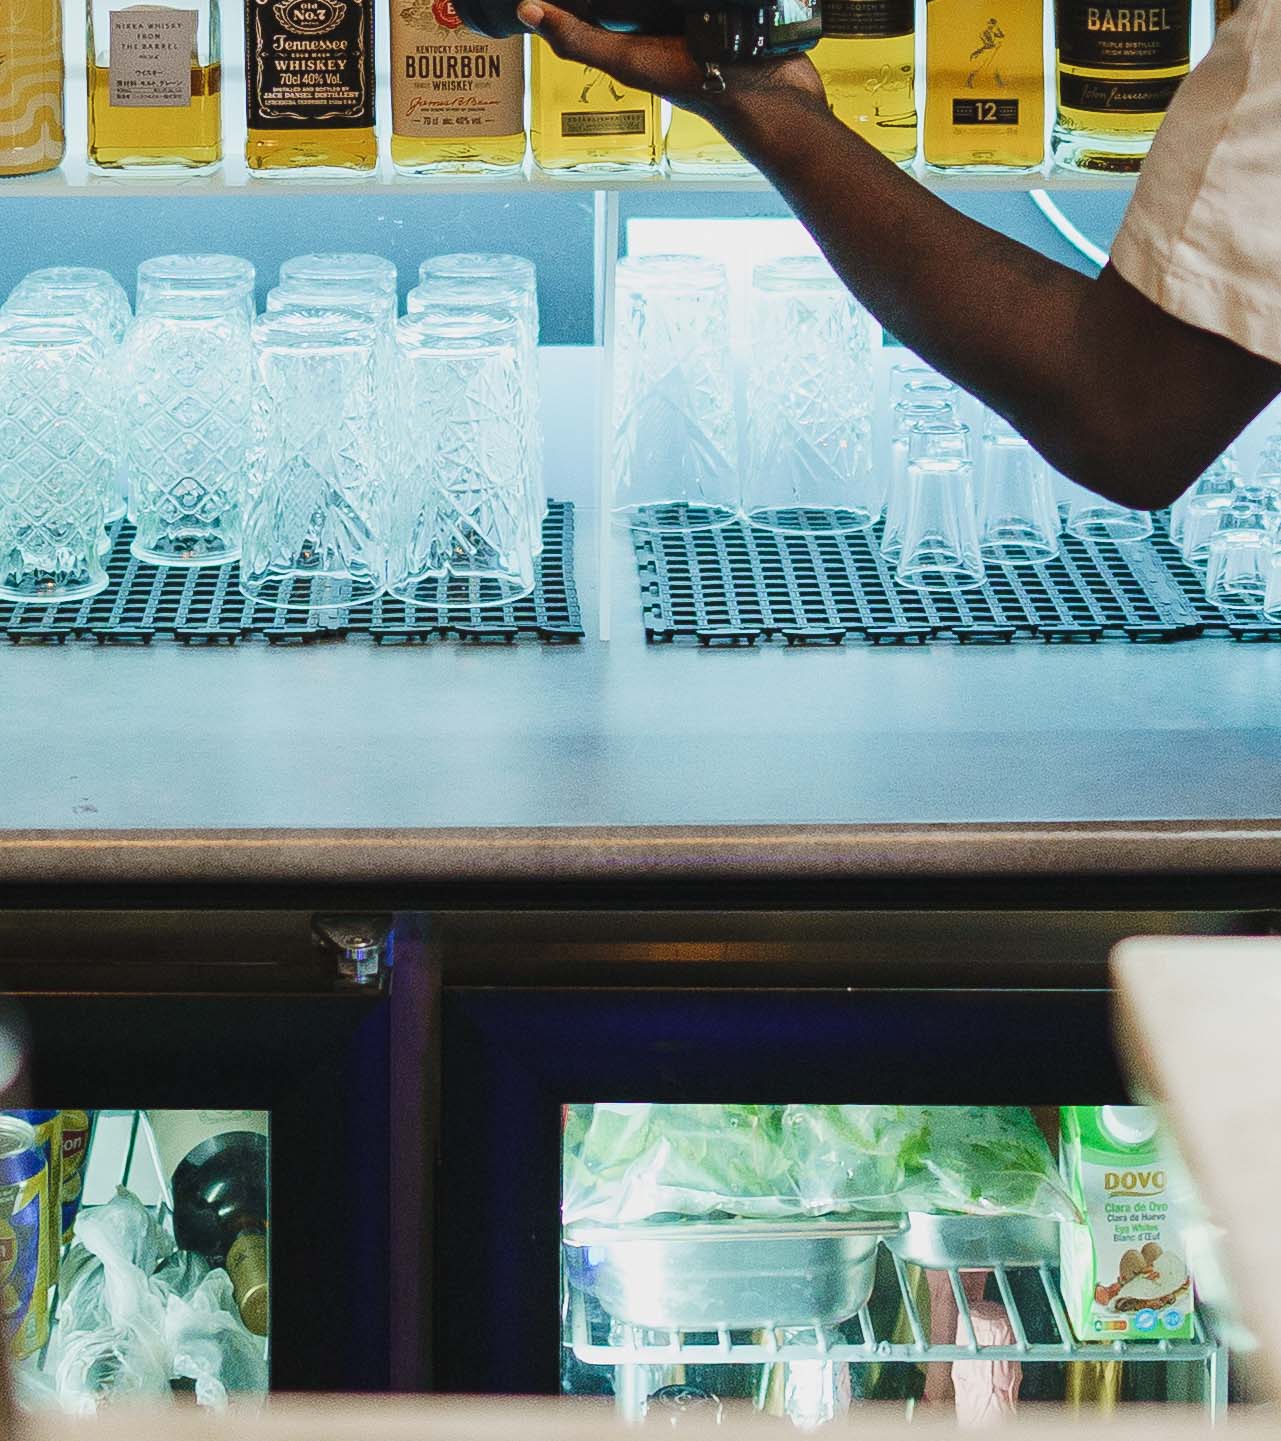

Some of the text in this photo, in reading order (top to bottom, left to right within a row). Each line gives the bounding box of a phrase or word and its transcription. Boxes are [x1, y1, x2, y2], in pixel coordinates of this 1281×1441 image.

[300, 2, 318, 10] Old
[292, 9, 327, 21] No.7
[1087, 7, 1171, 32] BARREL
[147, 22, 182, 30] WHISKY
[272, 34, 349, 52] Tennessee
[415, 44, 489, 56] KENTUCKY STRAIGHT
[274, 59, 348, 71] WHISKEY
[404, 54, 500, 79] BOURBON
[279, 73, 301, 86] 70cl
[301, 73, 324, 86] 40%
[431, 80, 473, 91] WHISKEY
[974, 102, 997, 121] 12
[1103, 1170, 1168, 1191] DOVO
[1104, 1201, 1131, 1214] Clara
[1148, 1201, 1169, 1213] Ovo
[1106, 1214, 1128, 1223] Clara
[1141, 1212, 1166, 1222] Huevo
[1114, 1224, 1130, 1236] Egg
[1113, 1232, 1135, 1242] Blanc
